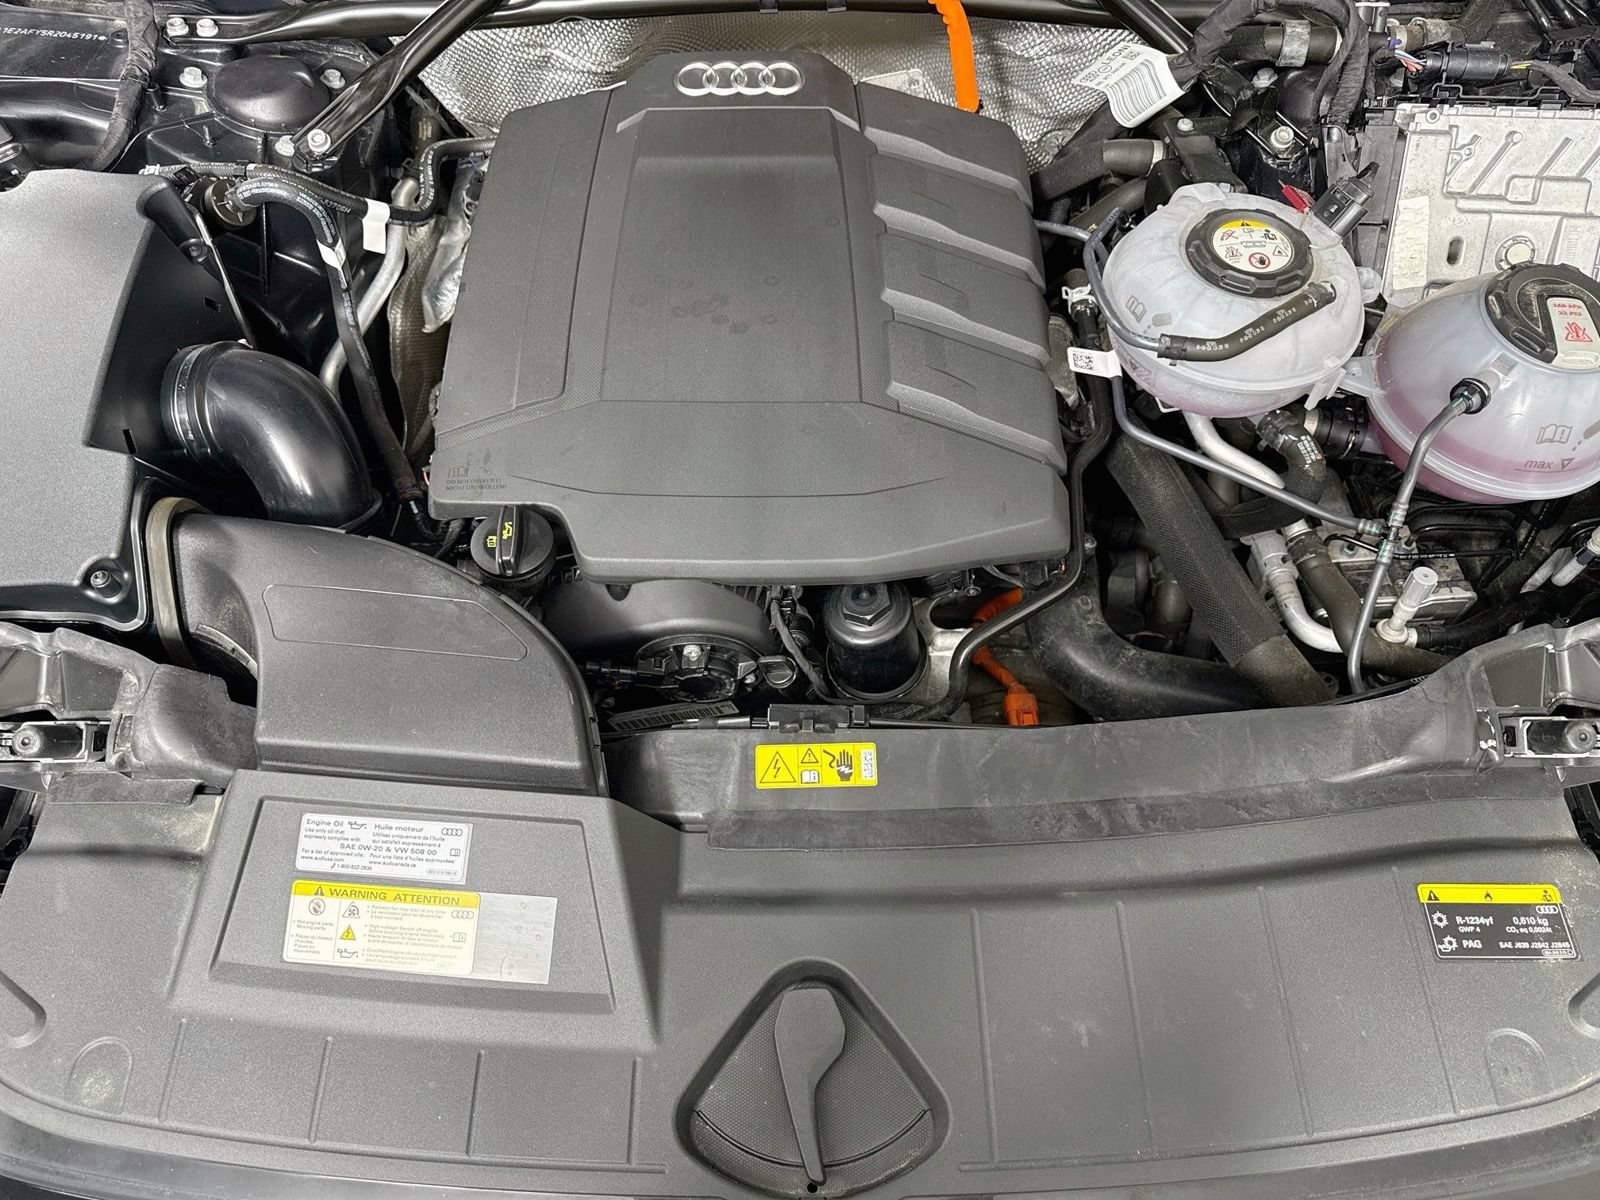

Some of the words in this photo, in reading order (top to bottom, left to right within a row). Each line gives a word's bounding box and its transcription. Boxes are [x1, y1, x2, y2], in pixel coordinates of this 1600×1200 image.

[1524, 460, 1554, 470] max
[306, 818, 331, 827] Engine
[374, 823, 393, 831] Huile
[339, 842, 356, 850] SAE
[357, 844, 384, 852] 0W-20
[394, 846, 409, 854] VW
[329, 887, 387, 901] WARNING
[393, 892, 460, 906] ATTENTION
[1536, 917, 1549, 927] kg
[1461, 939, 1483, 949] PAG
[1498, 941, 1513, 949] SAE
